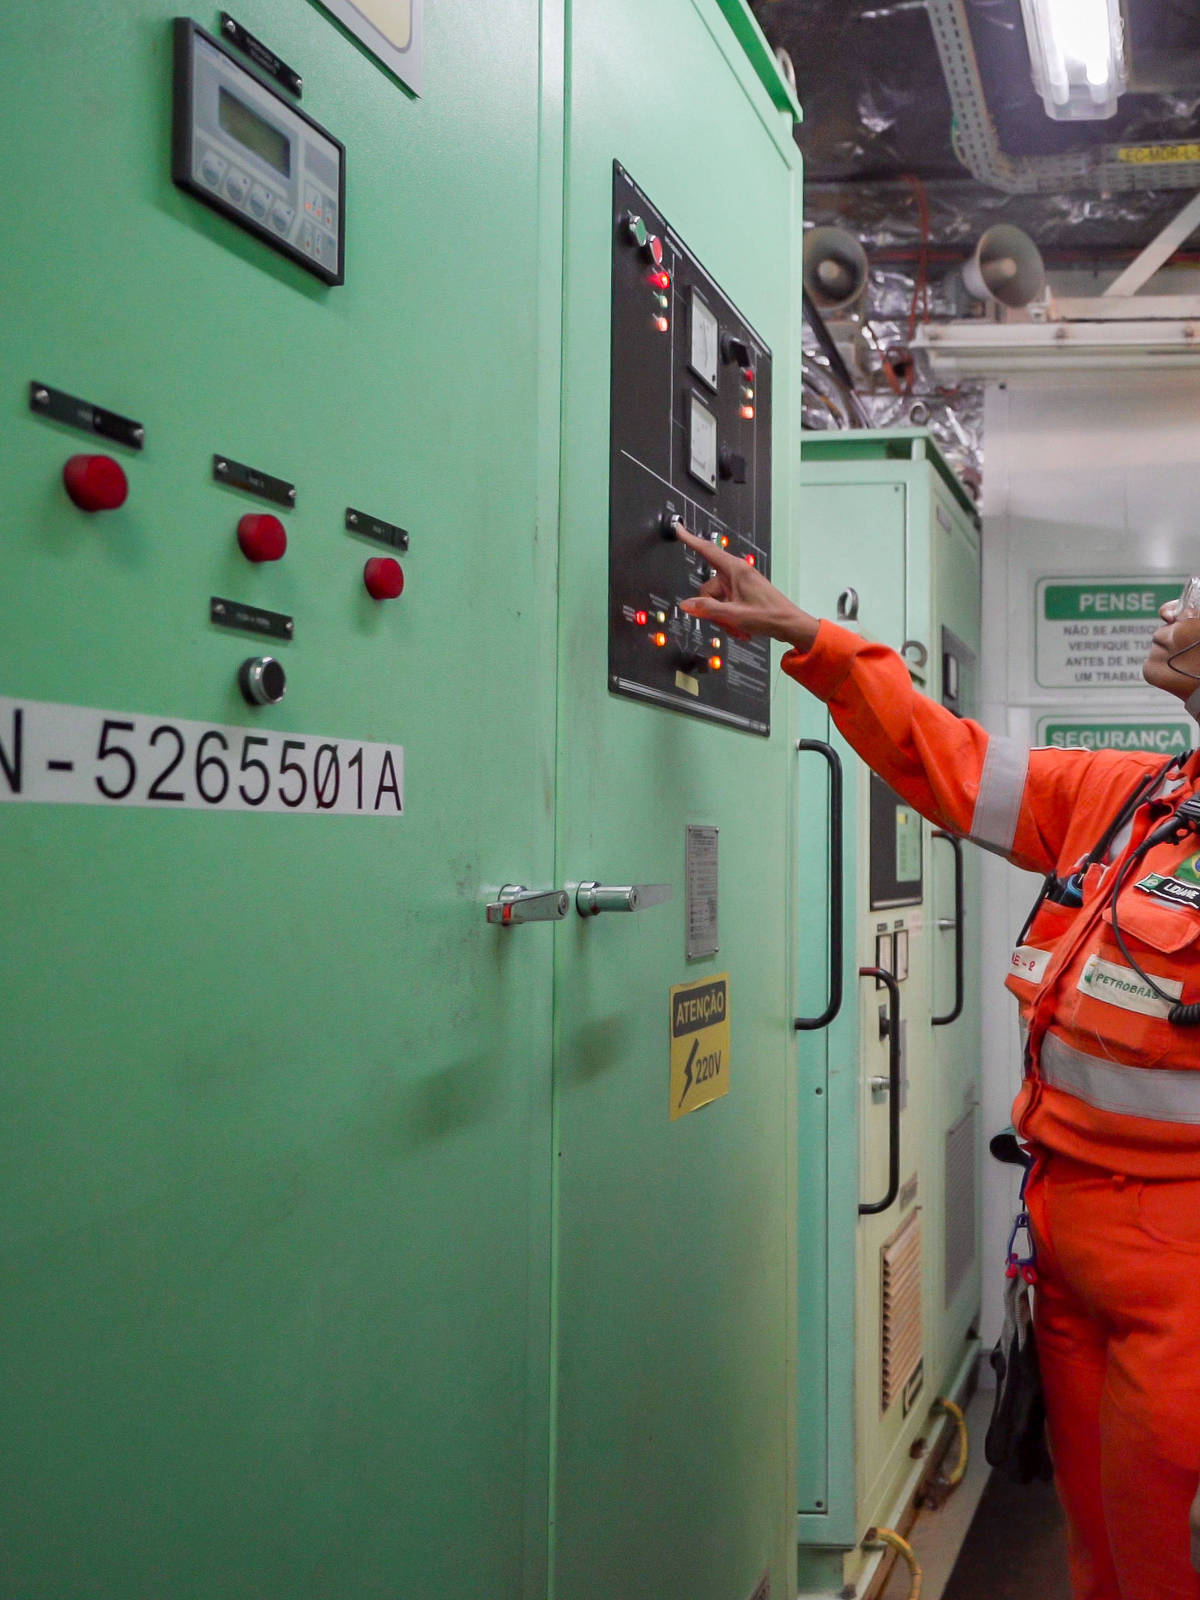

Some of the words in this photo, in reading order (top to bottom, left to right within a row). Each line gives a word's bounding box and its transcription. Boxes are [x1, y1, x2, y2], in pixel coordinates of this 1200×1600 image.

[1079, 591, 1156, 612] PENSE
[1063, 624, 1089, 635] NÃO
[1093, 625, 1106, 635] SE
[1111, 624, 1159, 635] ARRISQ
[1068, 640, 1130, 651] VERIFIQUE
[1134, 640, 1152, 650] TU
[1065, 656, 1104, 667] ANTES
[1108, 656, 1123, 667] DE
[1127, 656, 1145, 666] INI
[1074, 672, 1092, 682] UM
[1096, 671, 1141, 681] TRABAL
[1051, 729, 1186, 750] SEGURANÇA
[1095, 973, 1160, 999] PETROBRAS
[676, 991, 725, 1027] ATENÇÃO
[695, 1050, 722, 1085] 220V
